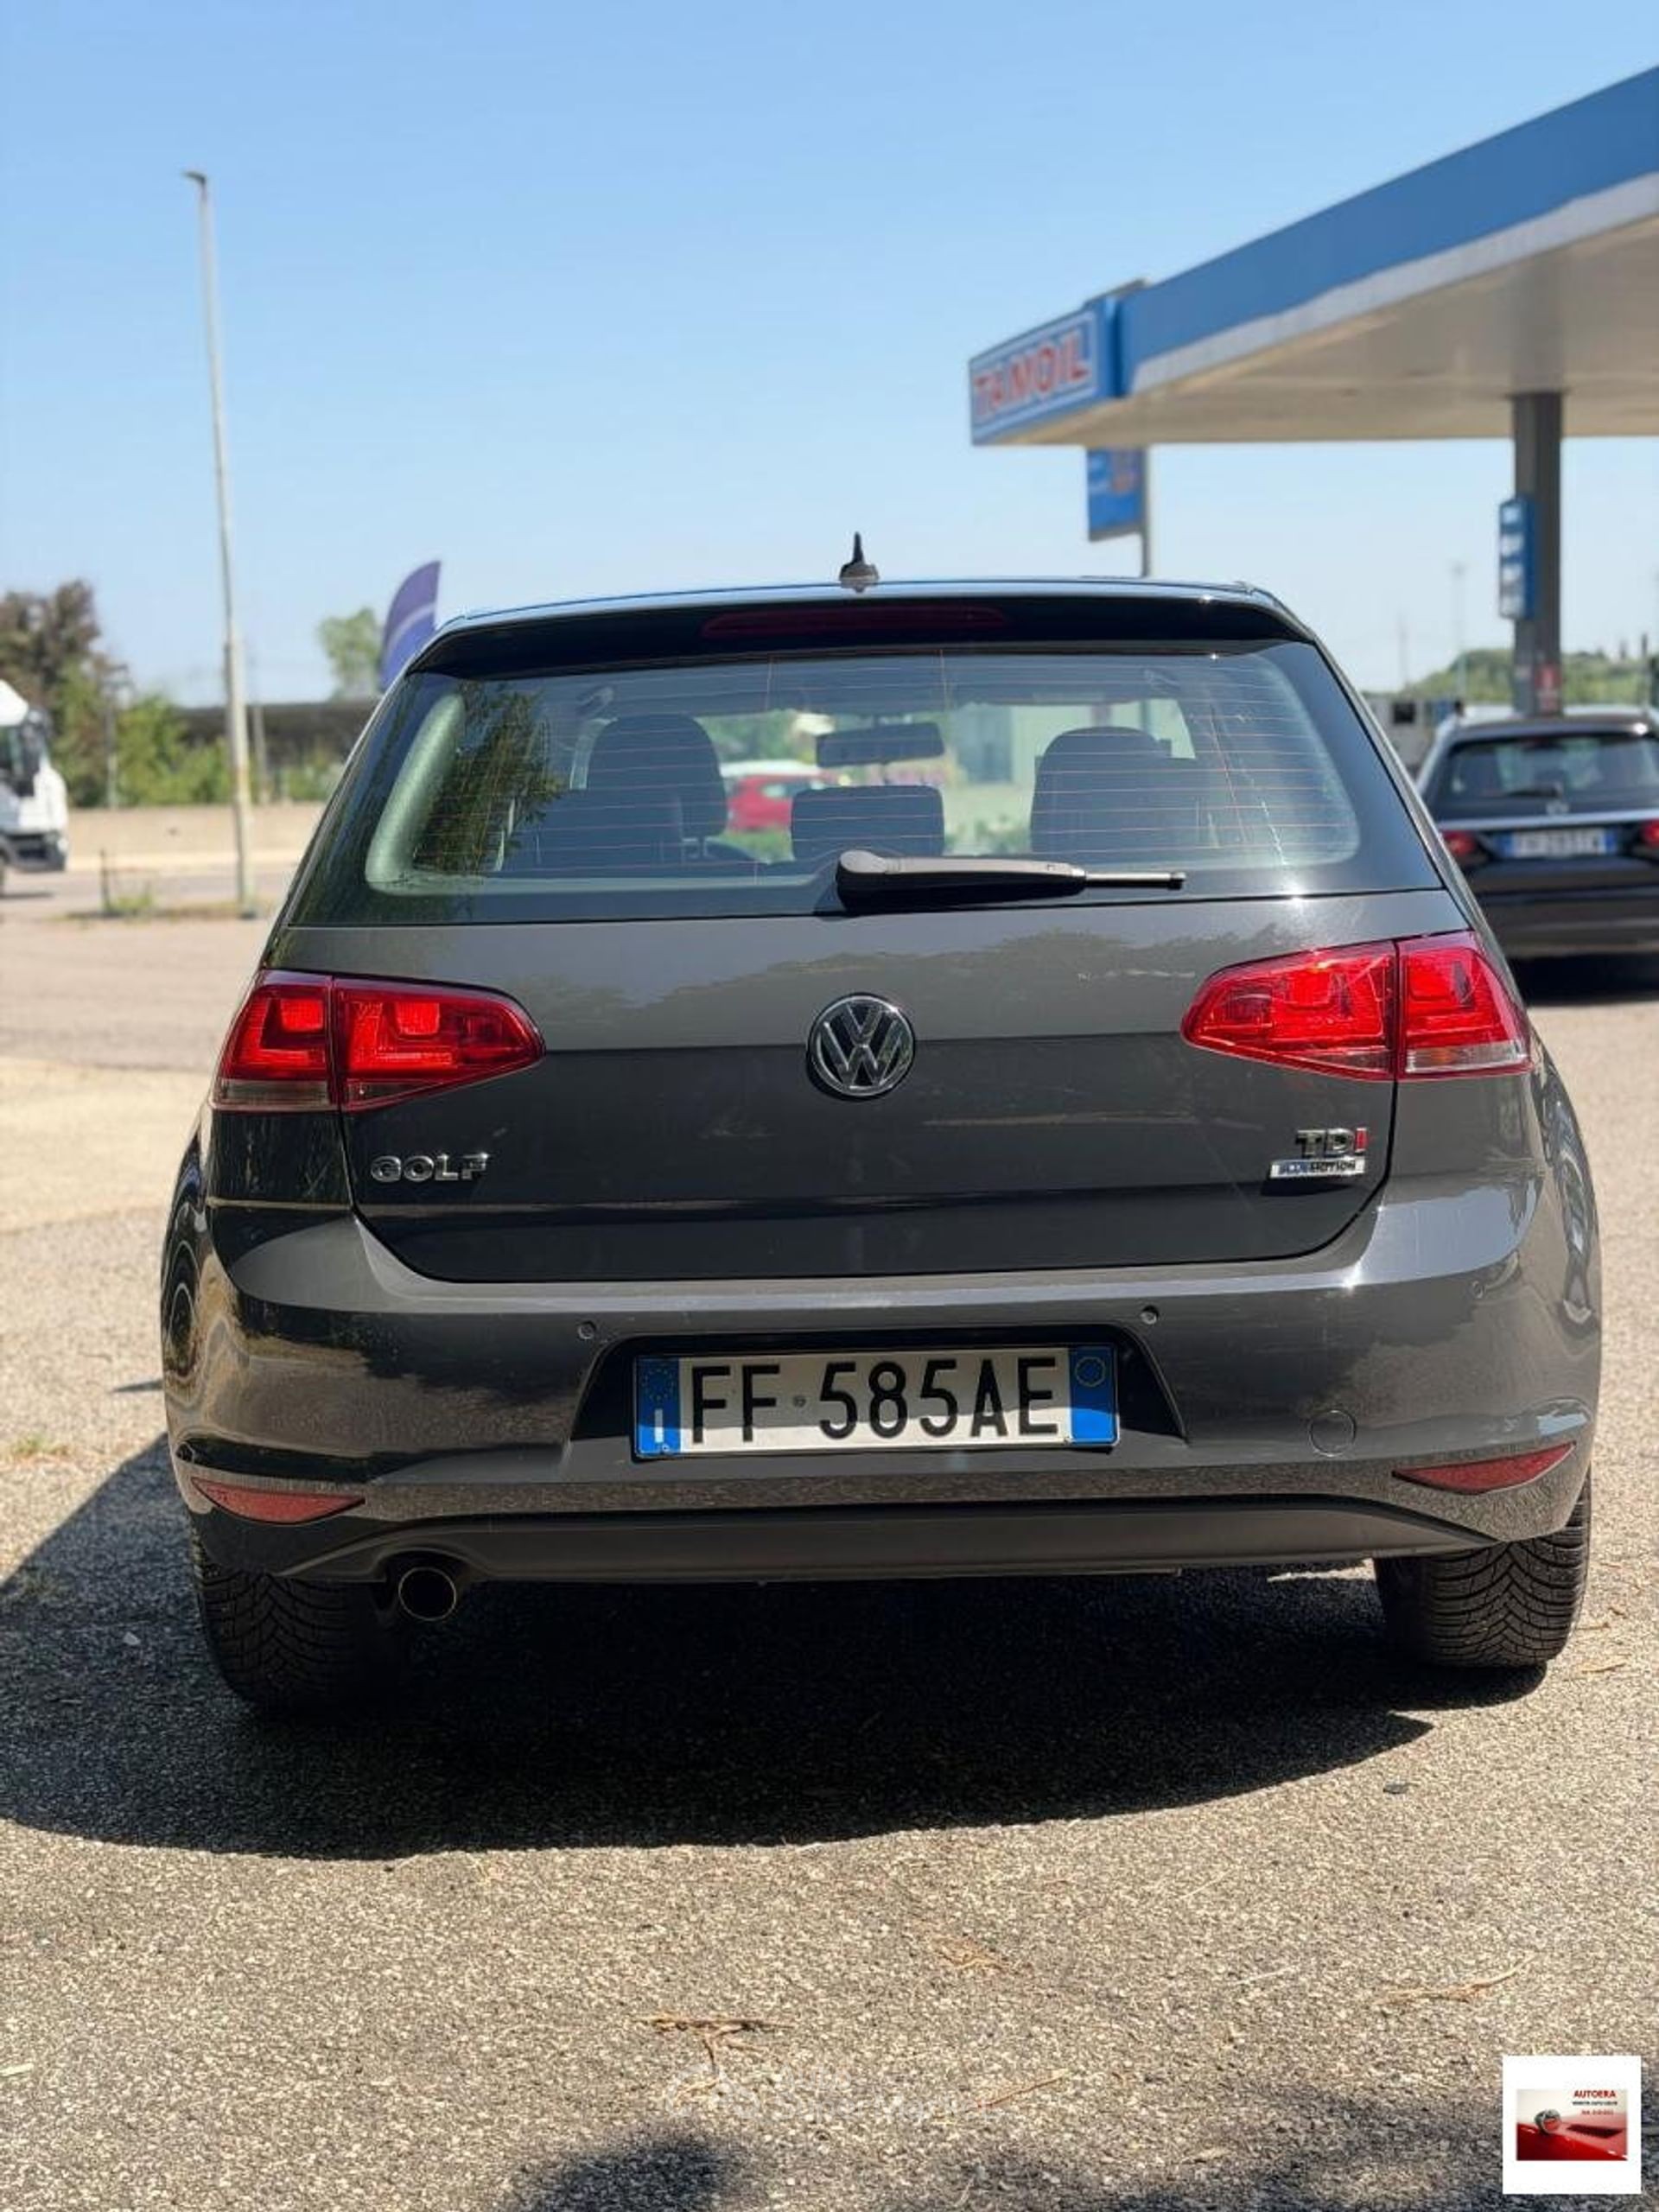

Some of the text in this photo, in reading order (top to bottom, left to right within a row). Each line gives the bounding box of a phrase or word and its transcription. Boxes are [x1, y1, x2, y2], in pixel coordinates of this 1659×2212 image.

[974, 331, 1089, 417] TAMOIL
[371, 1154, 488, 1182] GOLF
[1297, 1128, 1368, 1154] TDI
[692, 1357, 1060, 1444] FF 585AE
